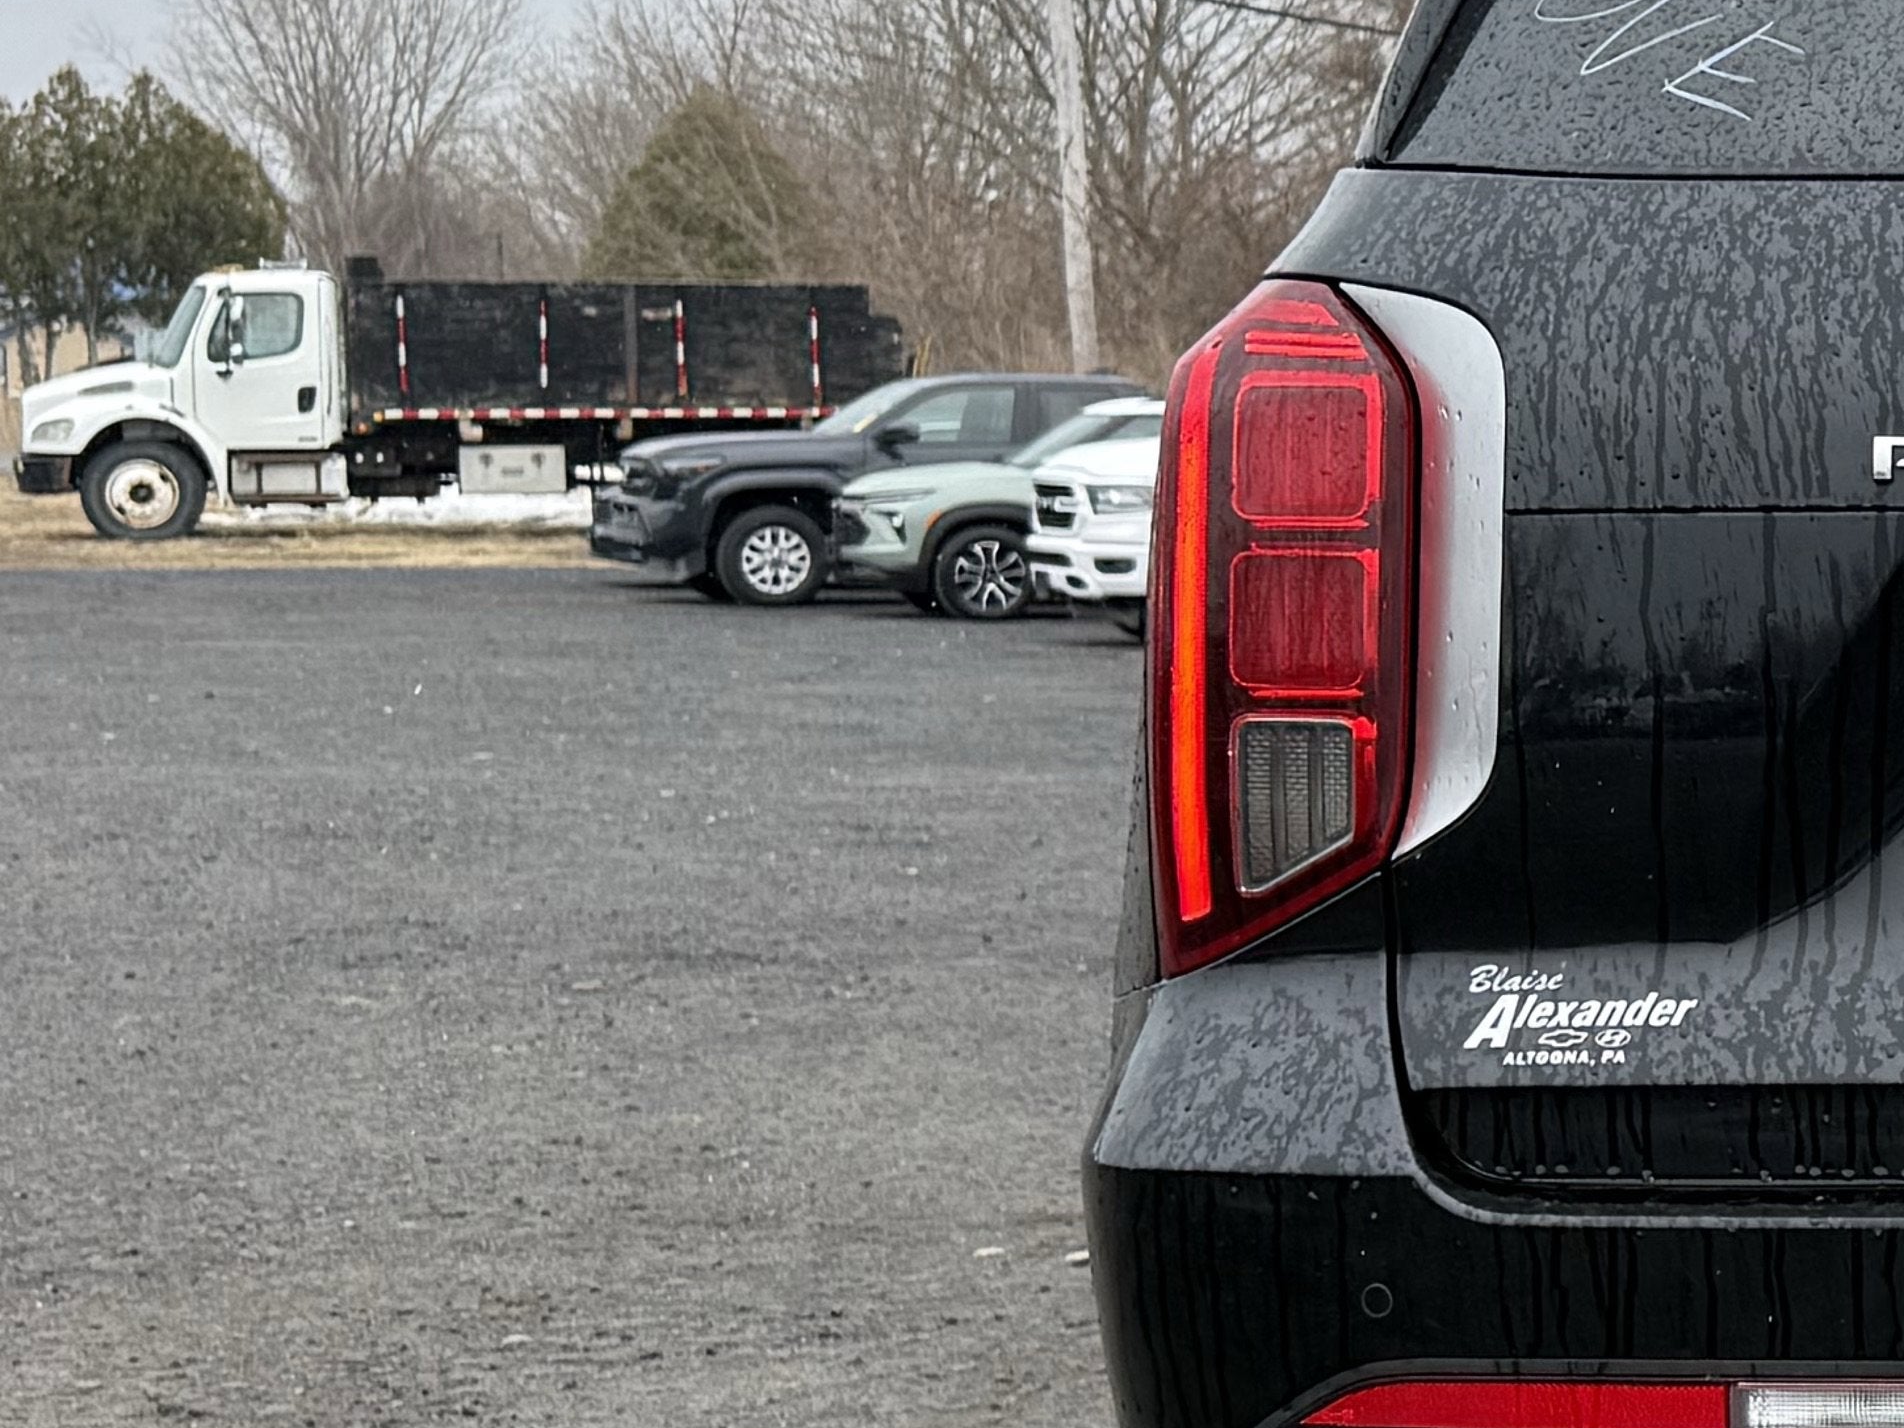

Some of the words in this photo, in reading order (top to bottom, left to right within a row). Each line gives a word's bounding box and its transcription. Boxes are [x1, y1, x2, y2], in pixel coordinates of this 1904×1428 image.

[1468, 964, 1564, 992] Blaise
[1463, 992, 1698, 1049] Alexander
[1502, 1049, 1597, 1067] ALTOONA,
[1601, 1049, 1626, 1066] PA
